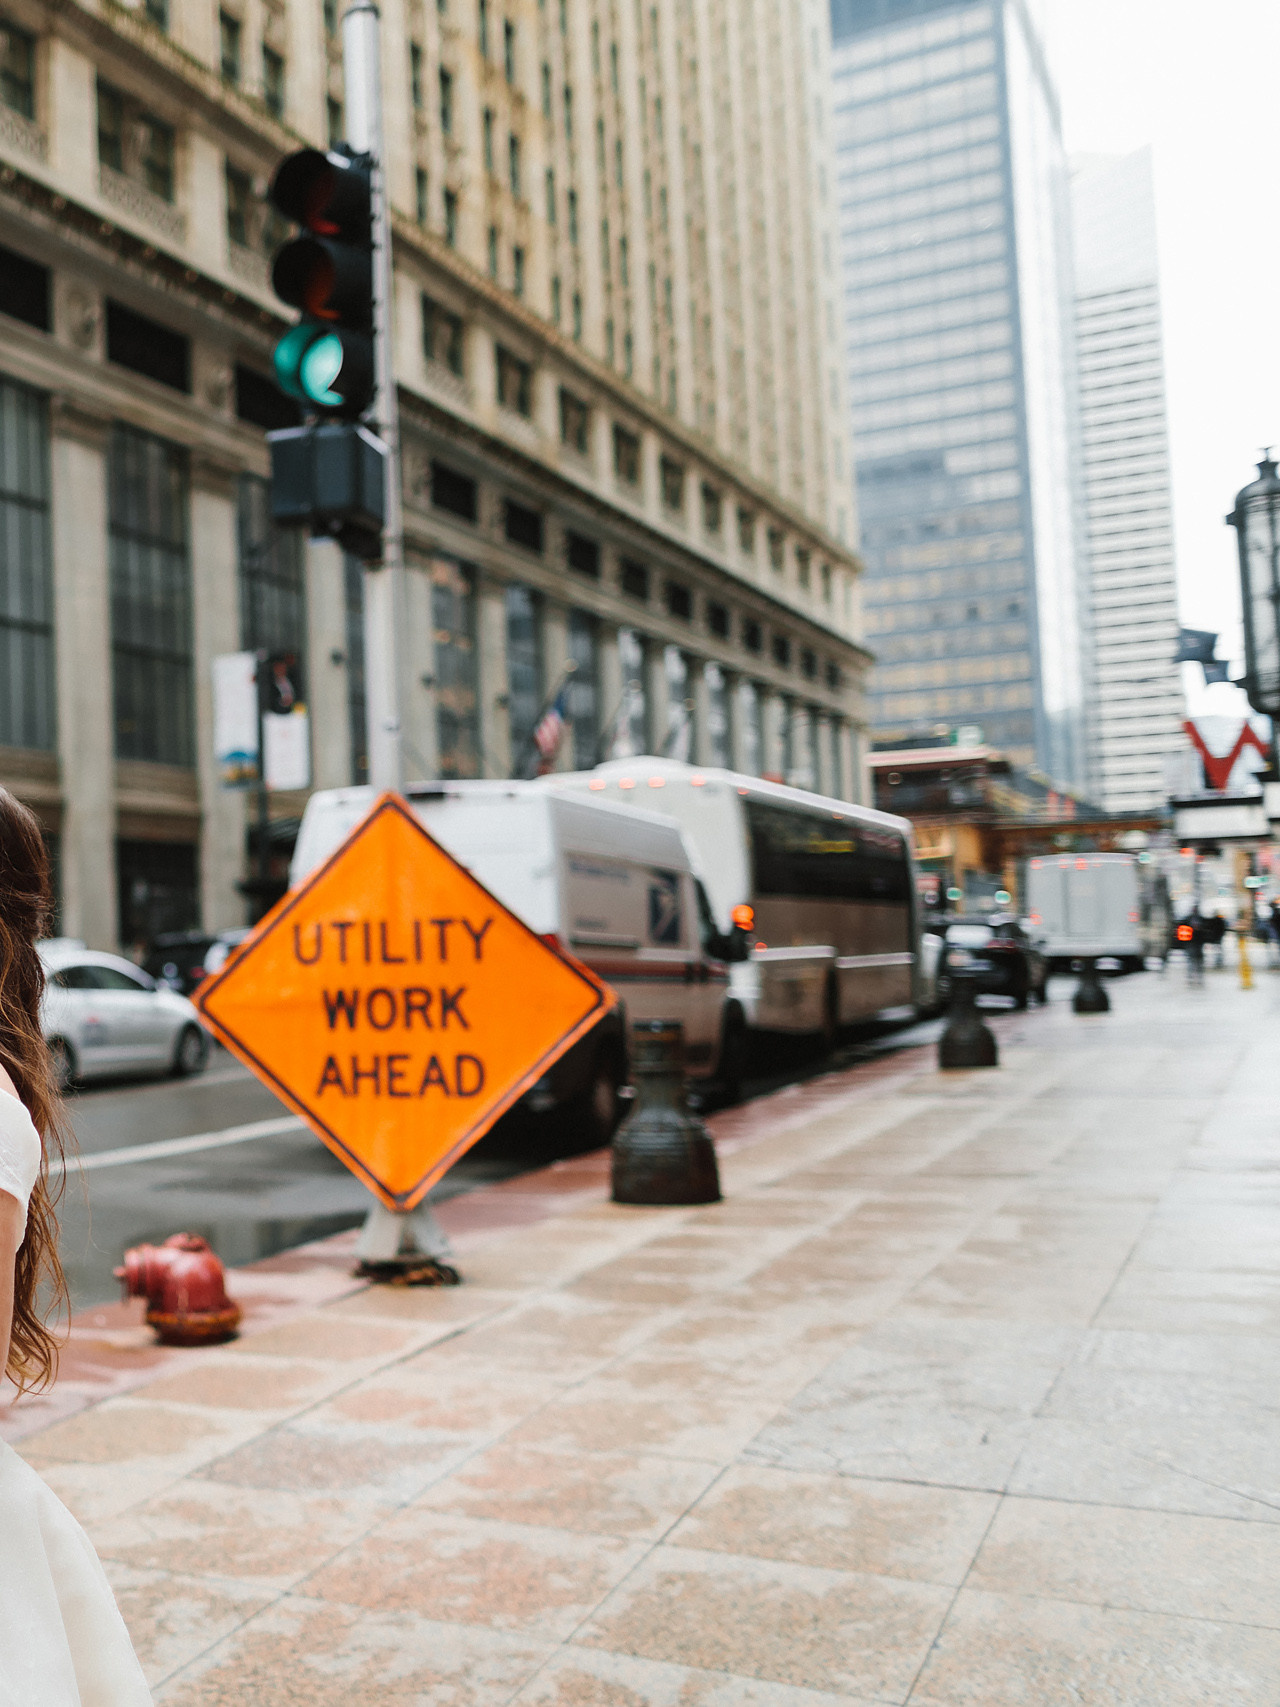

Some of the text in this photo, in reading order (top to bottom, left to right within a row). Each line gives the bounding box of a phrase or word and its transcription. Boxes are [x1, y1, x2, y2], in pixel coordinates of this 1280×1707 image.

[293, 918, 493, 965] UTILITY
[322, 986, 470, 1031] WORK
[317, 1053, 485, 1098] AHEAD
